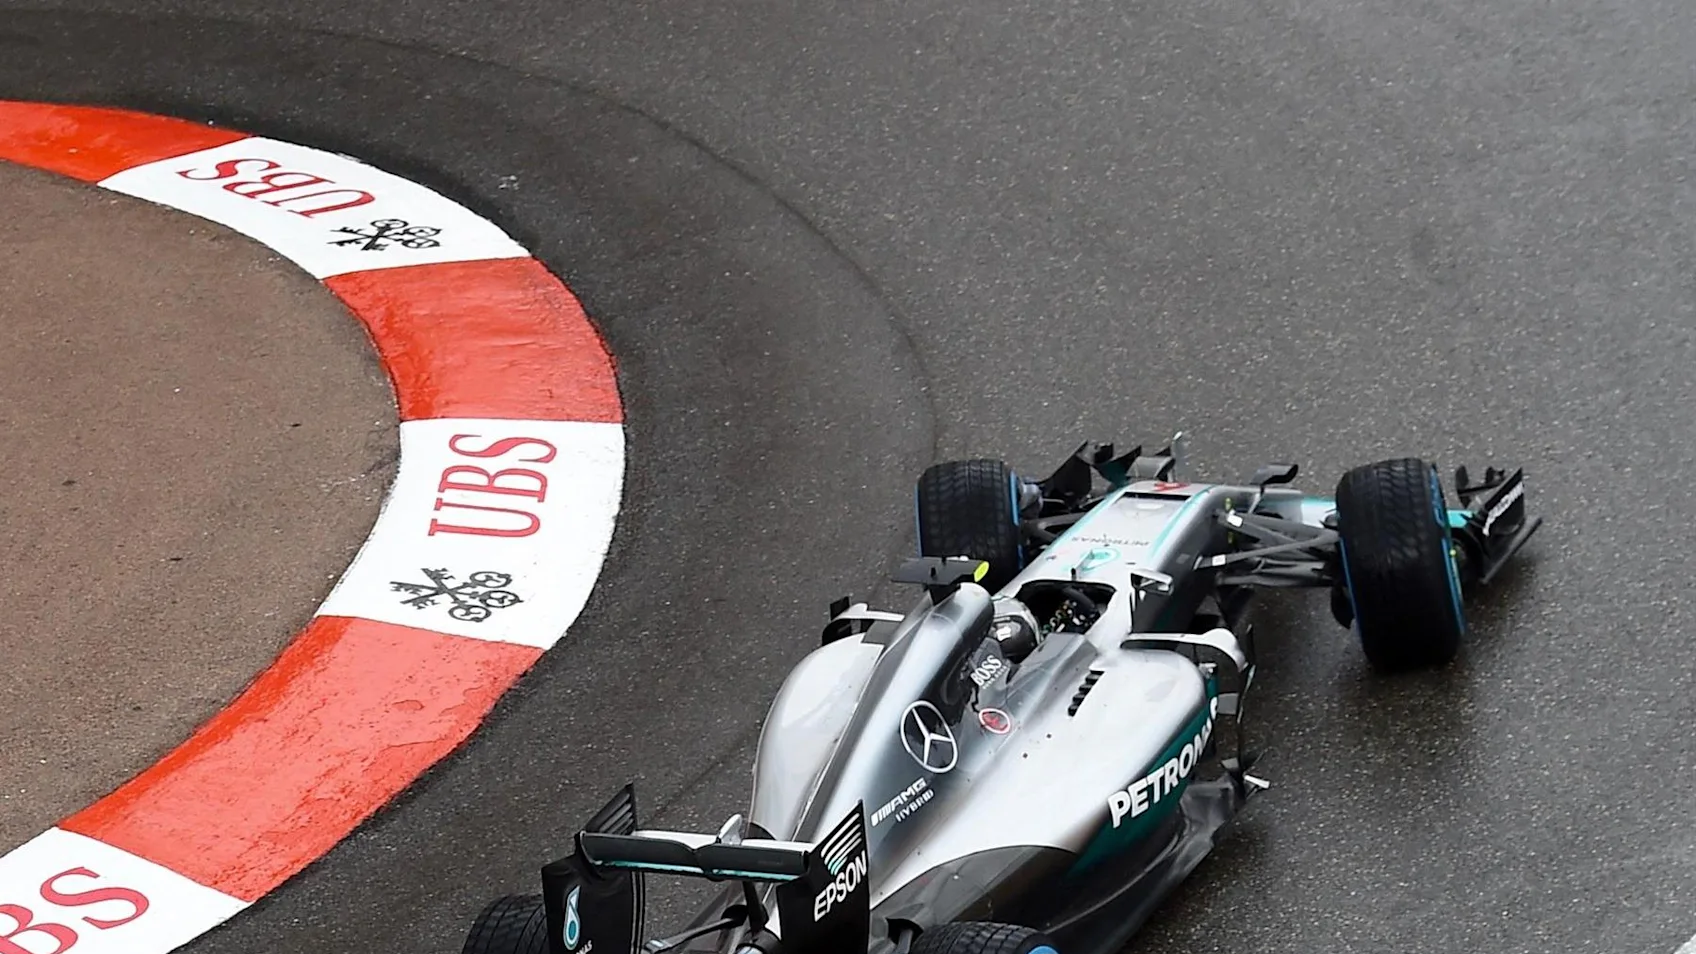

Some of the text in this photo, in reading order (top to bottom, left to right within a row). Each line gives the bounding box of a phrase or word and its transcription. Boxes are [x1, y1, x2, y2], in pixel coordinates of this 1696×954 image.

[176, 158, 376, 219] UBS
[427, 434, 557, 538] UBS
[970, 655, 1002, 686] BOSS
[895, 789, 935, 822] HYBRID
[814, 850, 867, 922] EPSON
